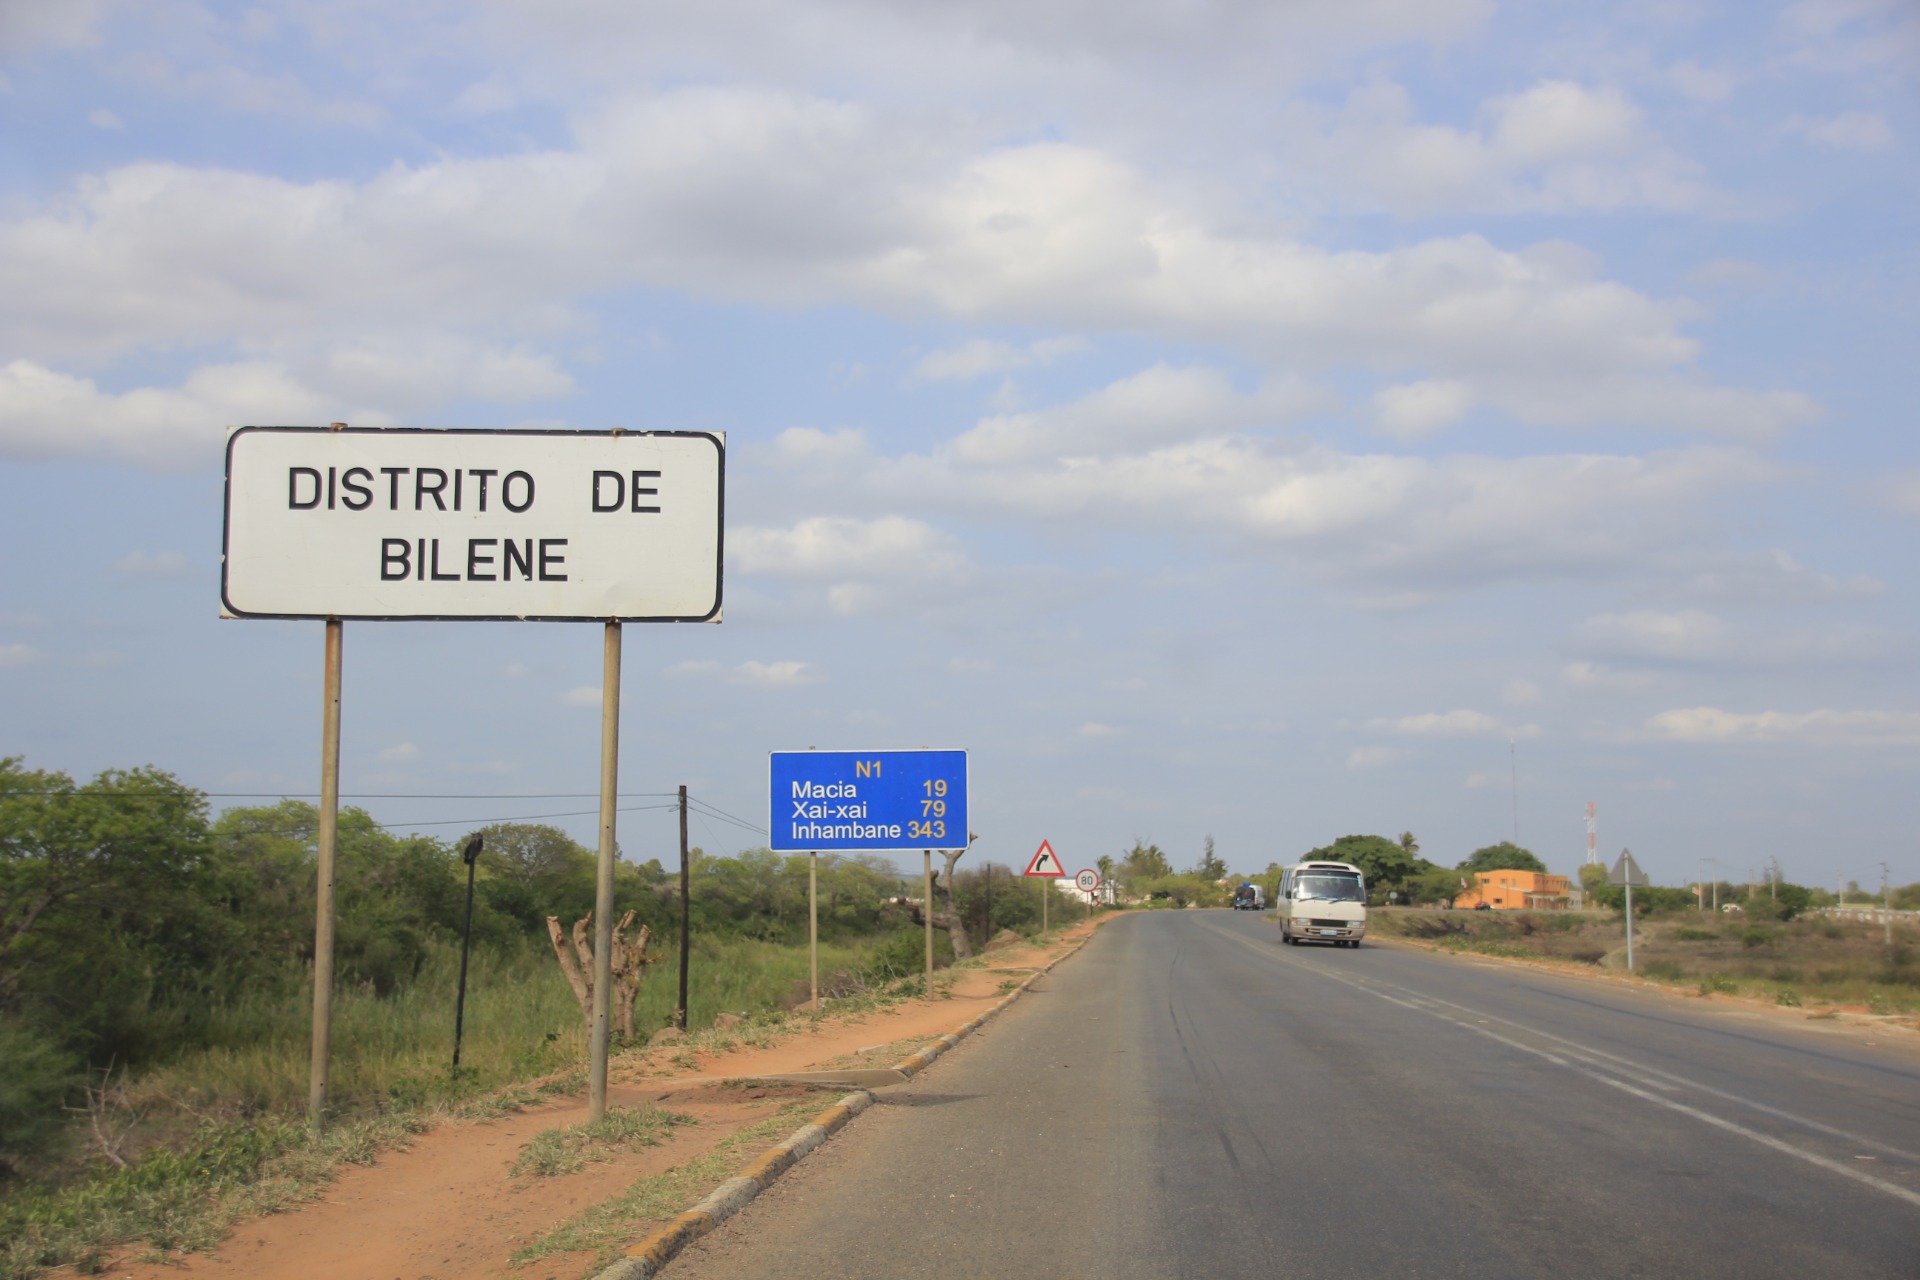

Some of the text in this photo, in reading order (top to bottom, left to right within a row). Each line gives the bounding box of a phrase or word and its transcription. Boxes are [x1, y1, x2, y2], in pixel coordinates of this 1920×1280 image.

[289, 467, 661, 513] DISTRITO DE
[381, 538, 568, 582] BILENE
[856, 760, 882, 778] N1
[792, 779, 947, 798] Macia 19
[792, 800, 946, 818] Xai-xai 79
[792, 821, 946, 839] Inhambane 343
[1081, 876, 1093, 886] 80
